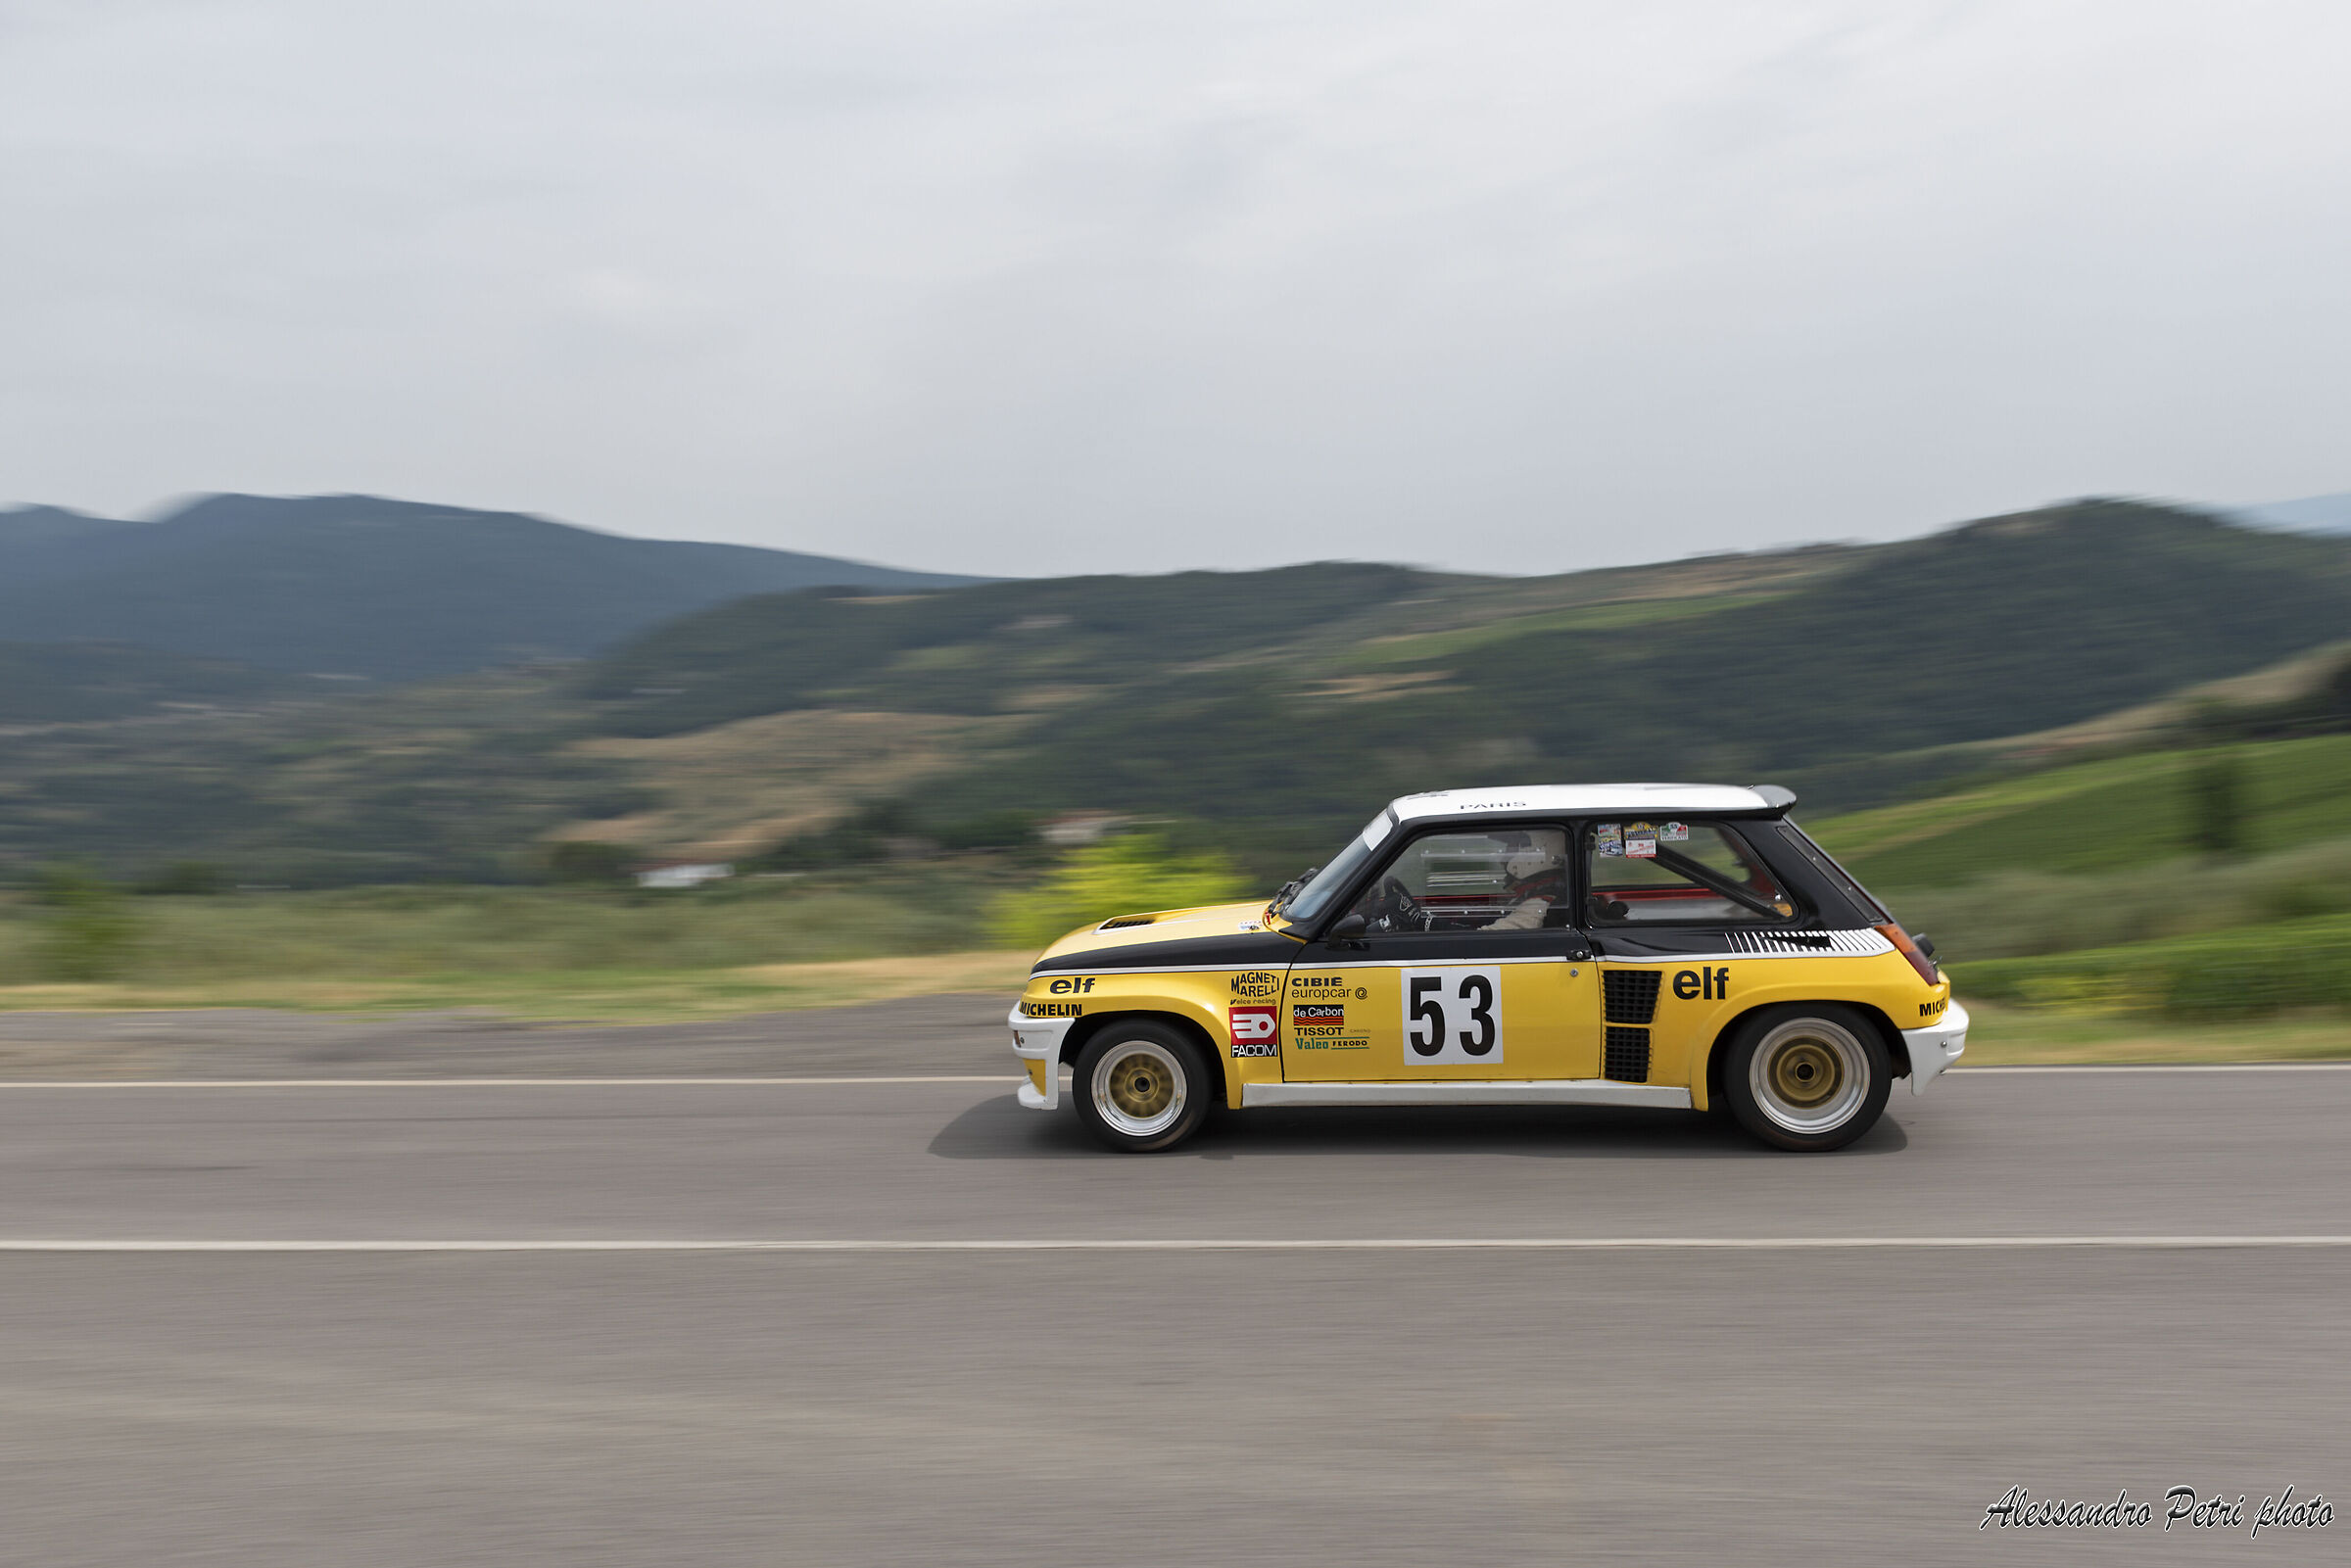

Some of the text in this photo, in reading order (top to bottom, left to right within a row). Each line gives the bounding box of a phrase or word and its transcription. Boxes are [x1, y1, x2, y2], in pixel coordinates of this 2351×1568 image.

[1049, 977, 1095, 994] elf
[1231, 972, 1279, 986] MAGNETI
[1672, 966, 1729, 1000] elf
[1231, 983, 1279, 997] MARELLI
[1291, 987, 1352, 1000] europcar
[1020, 1002, 1082, 1016] MICHELIN
[1293, 1007, 1344, 1018] de Carbon
[1410, 974, 1495, 1057] 53
[1294, 1026, 1344, 1036] TISSOT
[1231, 1044, 1277, 1057] FACOM
[1295, 1037, 1329, 1050] Valeo
